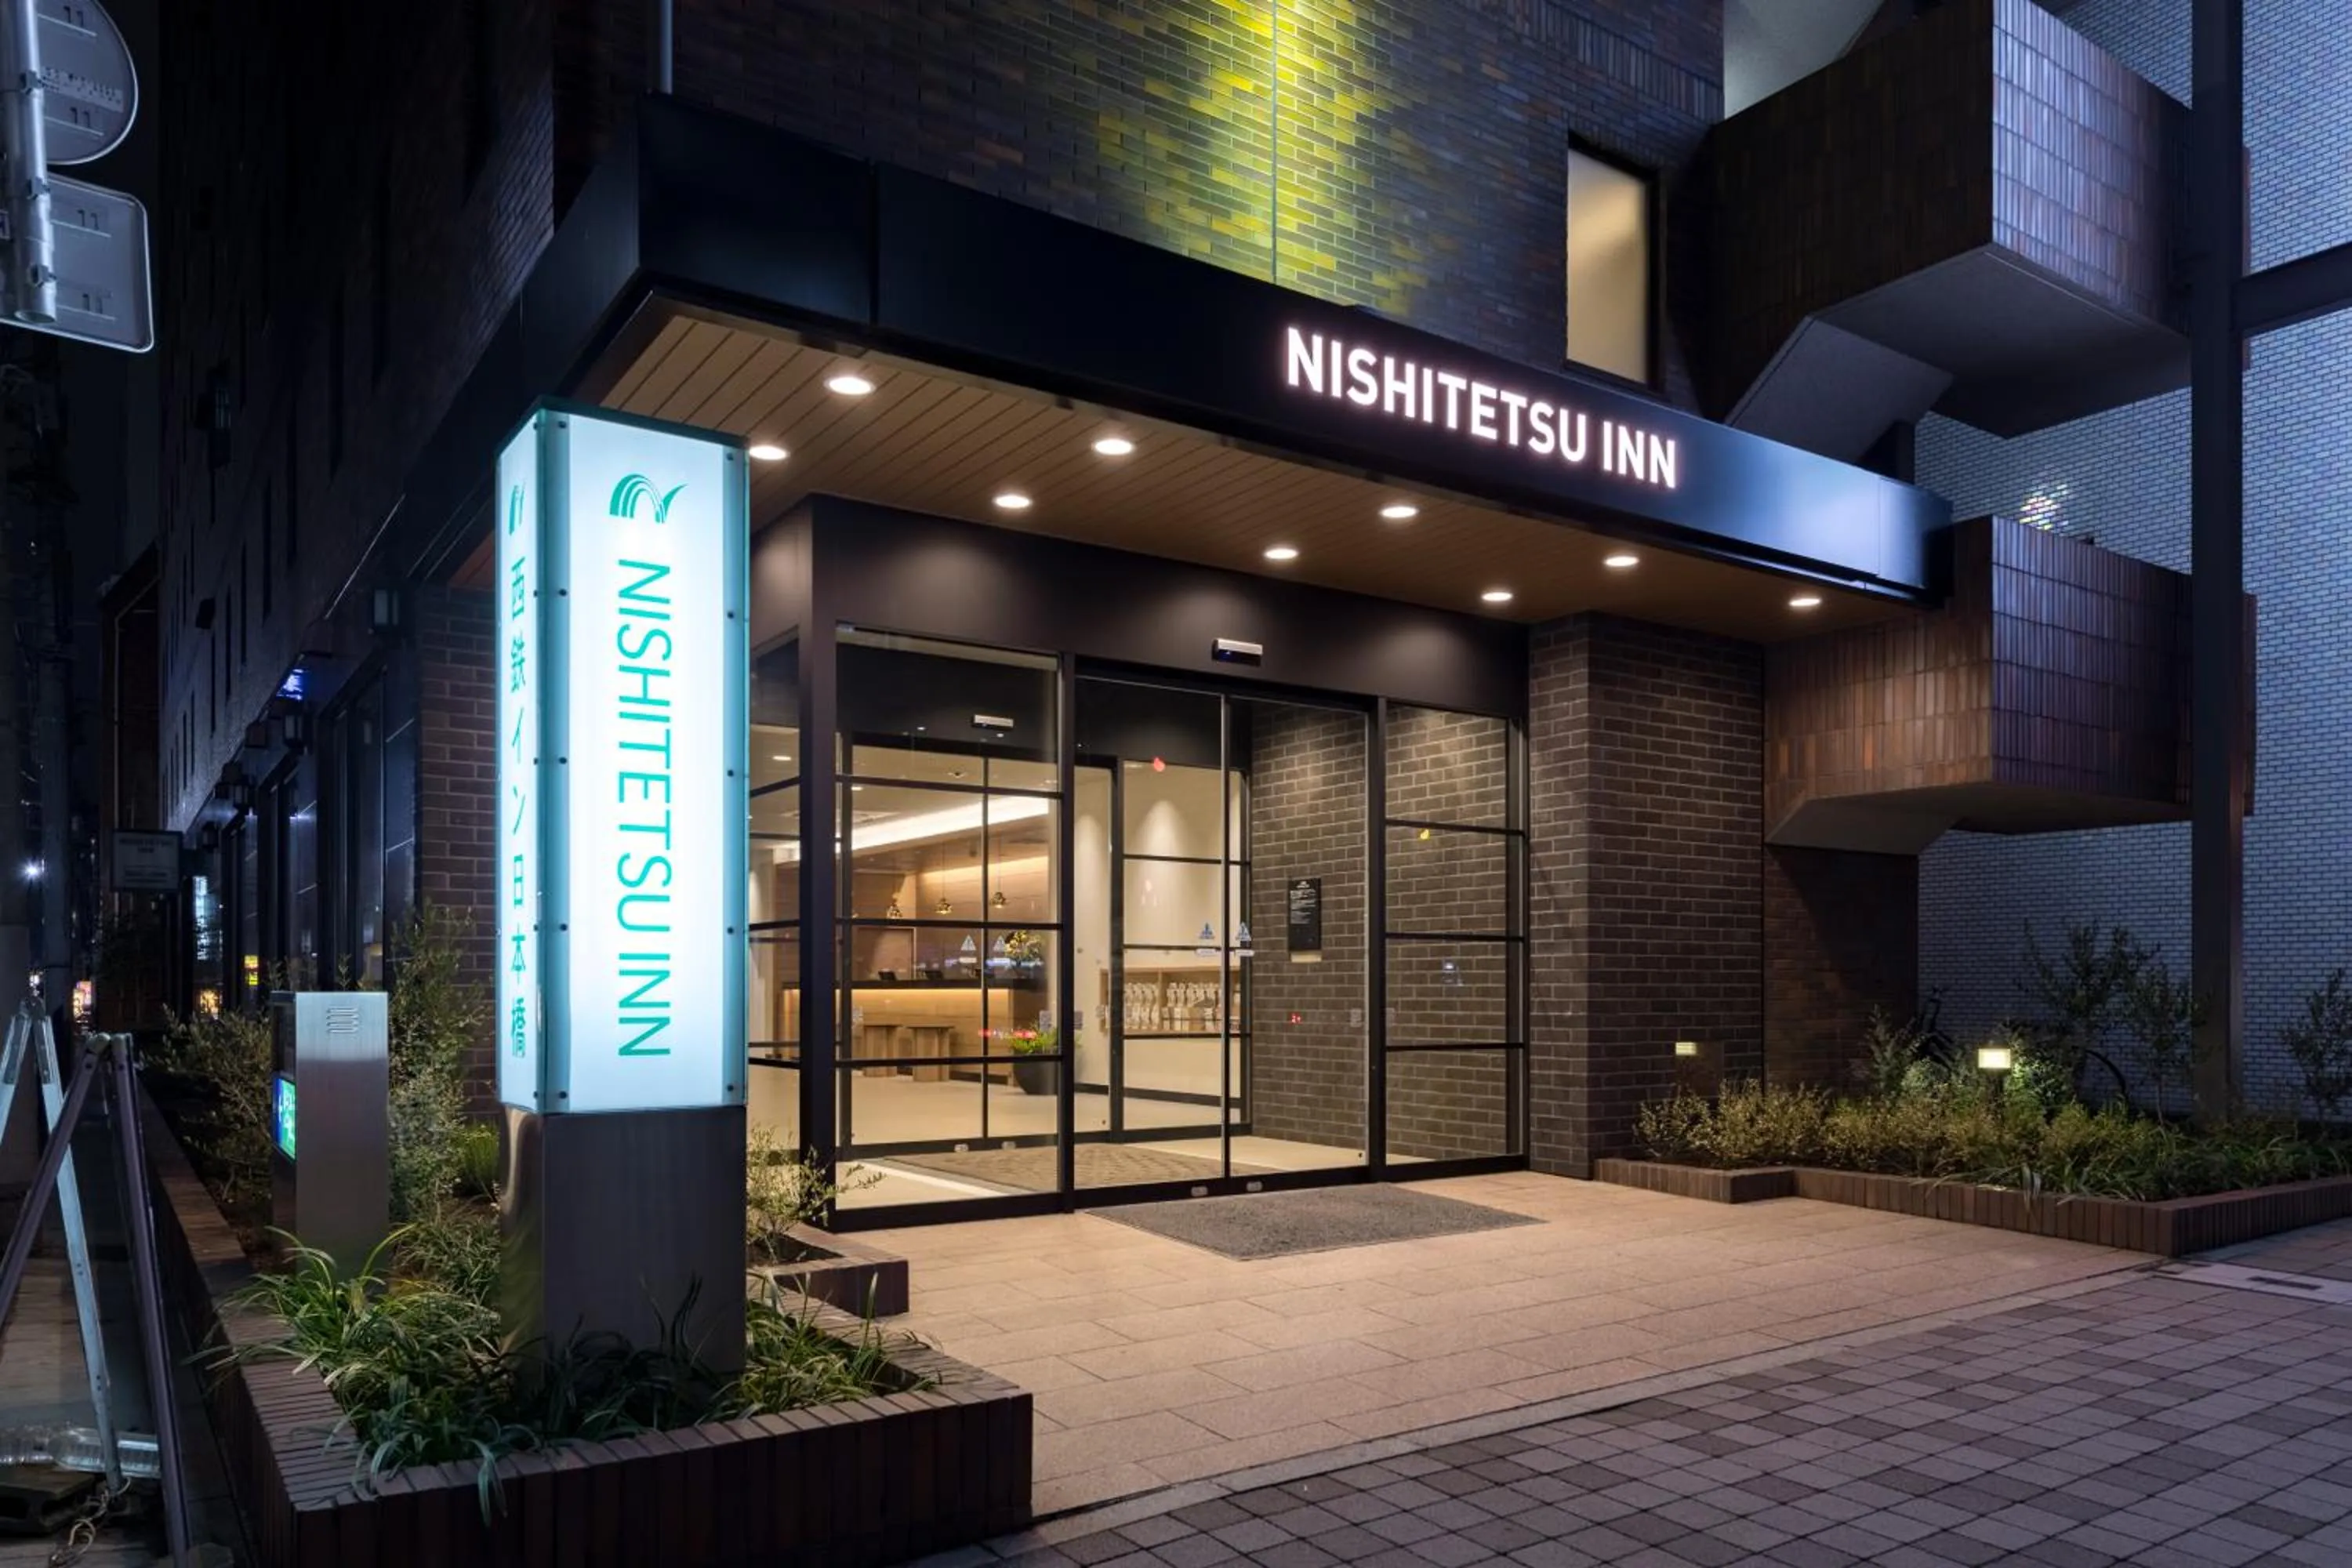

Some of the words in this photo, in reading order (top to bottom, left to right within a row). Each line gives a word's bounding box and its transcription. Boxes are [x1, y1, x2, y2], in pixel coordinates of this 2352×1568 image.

[1287, 327, 1587, 462] NISHITETSU
[1603, 421, 1675, 488] INN
[510, 556, 527, 1057] 西鉄イン日本橋
[617, 560, 672, 932] NISHITETSU
[617, 952, 672, 1058] INN
